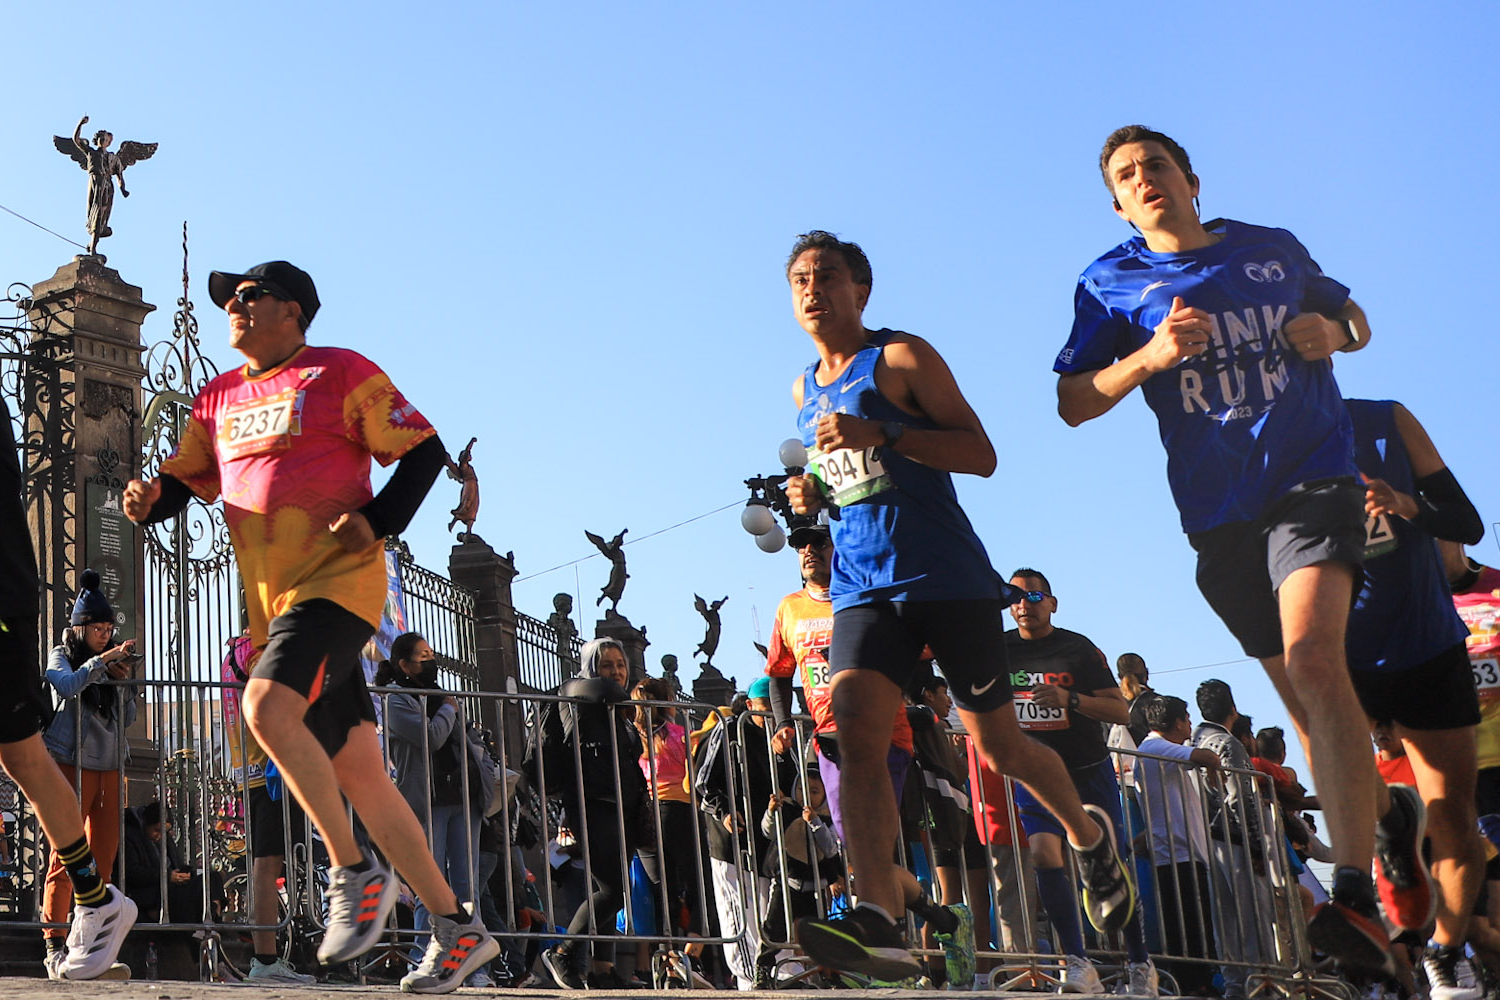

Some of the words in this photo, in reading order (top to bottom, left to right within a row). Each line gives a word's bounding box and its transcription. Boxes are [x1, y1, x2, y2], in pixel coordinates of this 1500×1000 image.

[1180, 354, 1290, 414] RUN
[229, 406, 286, 440] 6237
[1227, 406, 1252, 421] 023
[1009, 669, 1074, 688] ÉXICO
